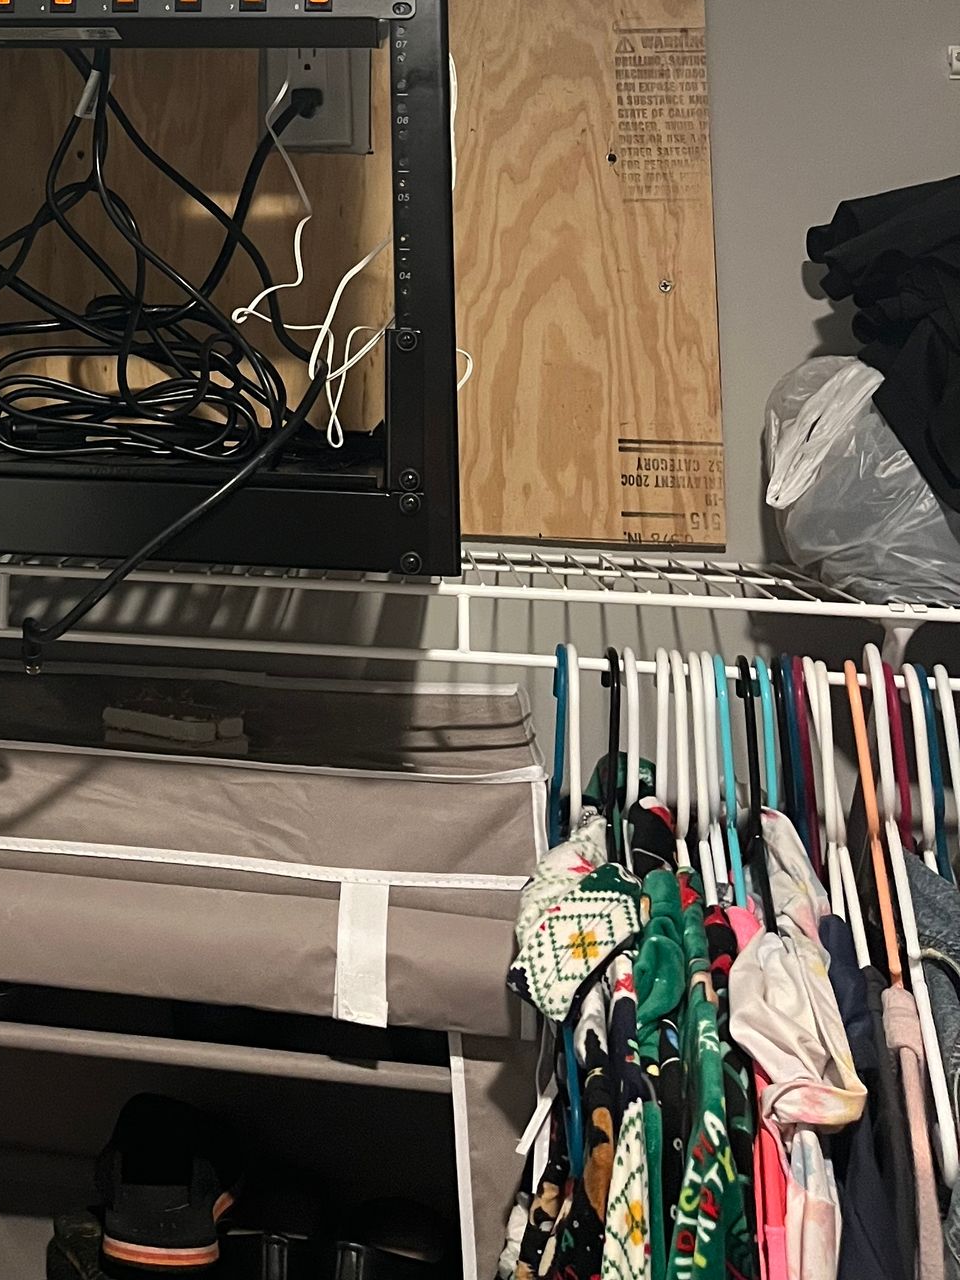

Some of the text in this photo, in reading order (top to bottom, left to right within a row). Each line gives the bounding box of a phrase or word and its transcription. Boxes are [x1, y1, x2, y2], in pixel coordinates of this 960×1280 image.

[395, 40, 408, 49] 07
[626, 94, 686, 106] SUBSTANCE
[617, 107, 649, 120] STATE
[651, 107, 666, 119] OF
[396, 116, 409, 125] 06
[397, 193, 410, 202] 05
[399, 271, 411, 280] 04
[636, 457, 701, 473] CATEGORY
